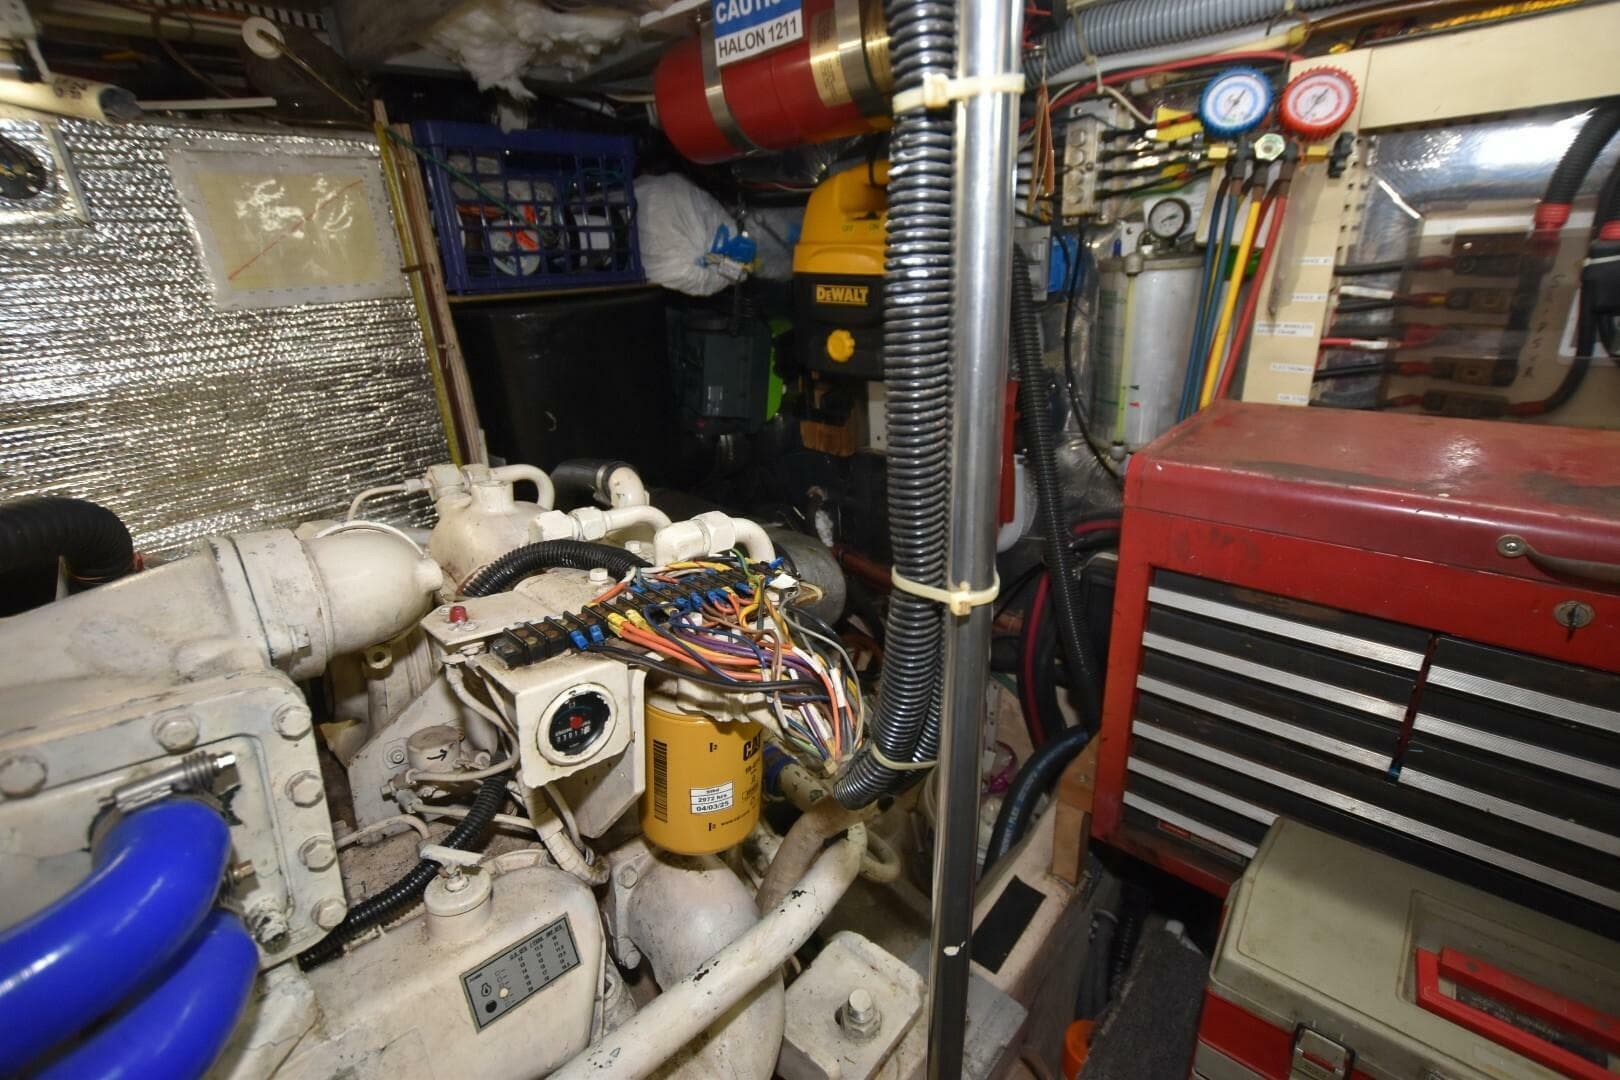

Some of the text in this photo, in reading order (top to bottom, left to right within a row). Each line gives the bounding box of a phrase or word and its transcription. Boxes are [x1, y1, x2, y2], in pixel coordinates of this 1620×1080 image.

[716, 0, 781, 24] CAU
[719, 28, 765, 58] HALON
[768, 16, 796, 41] 1211
[696, 801, 729, 812] 04/03/25
